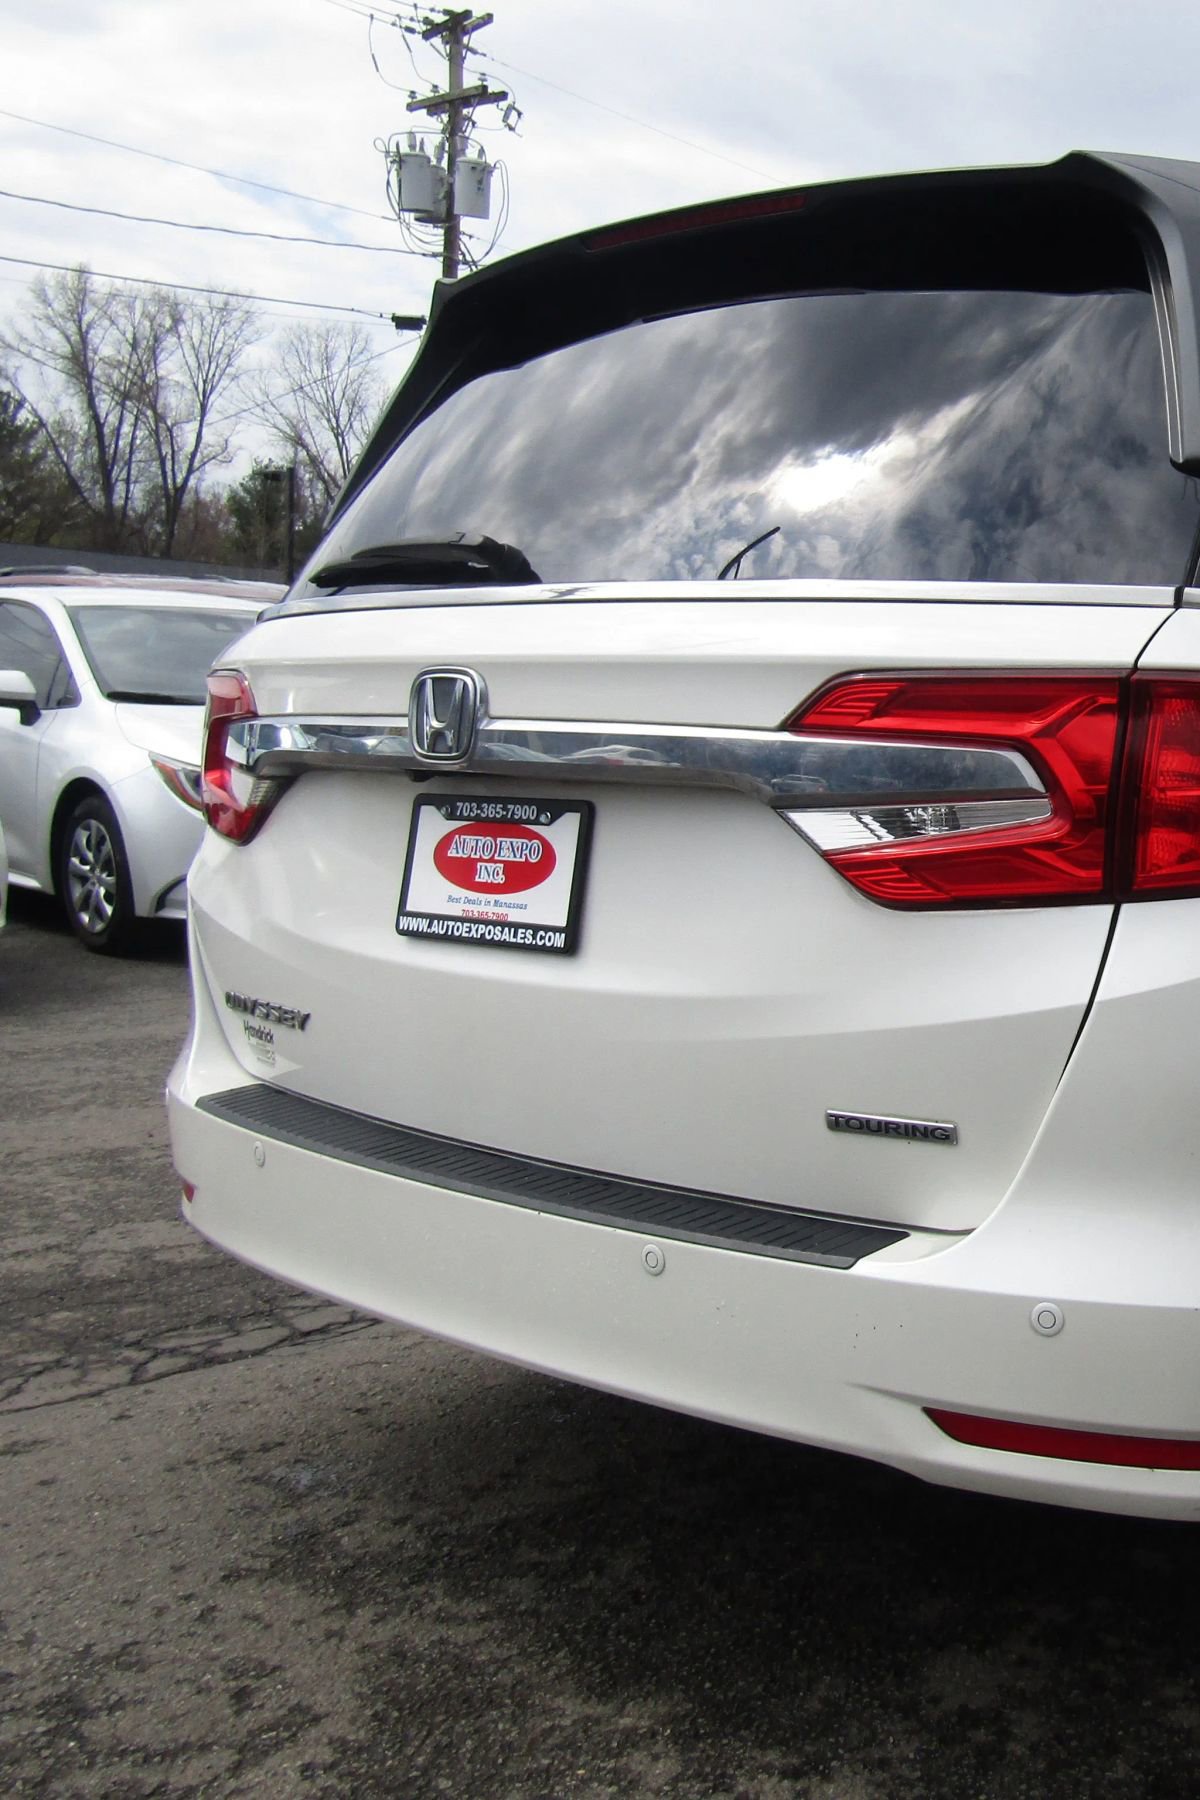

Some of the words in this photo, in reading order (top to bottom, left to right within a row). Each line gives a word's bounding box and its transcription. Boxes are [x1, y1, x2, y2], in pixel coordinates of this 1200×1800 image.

[456, 802, 537, 820] 703-365-7900
[449, 836, 494, 858] AUTO
[496, 839, 542, 862] EXPO
[475, 862, 506, 883] INC.
[447, 895, 462, 903] Best
[463, 896, 482, 906] Deals
[493, 898, 528, 909] Manassas
[399, 916, 566, 948] WWW.AUTOEXPOSALES.COM
[829, 1114, 950, 1140] TOURING
